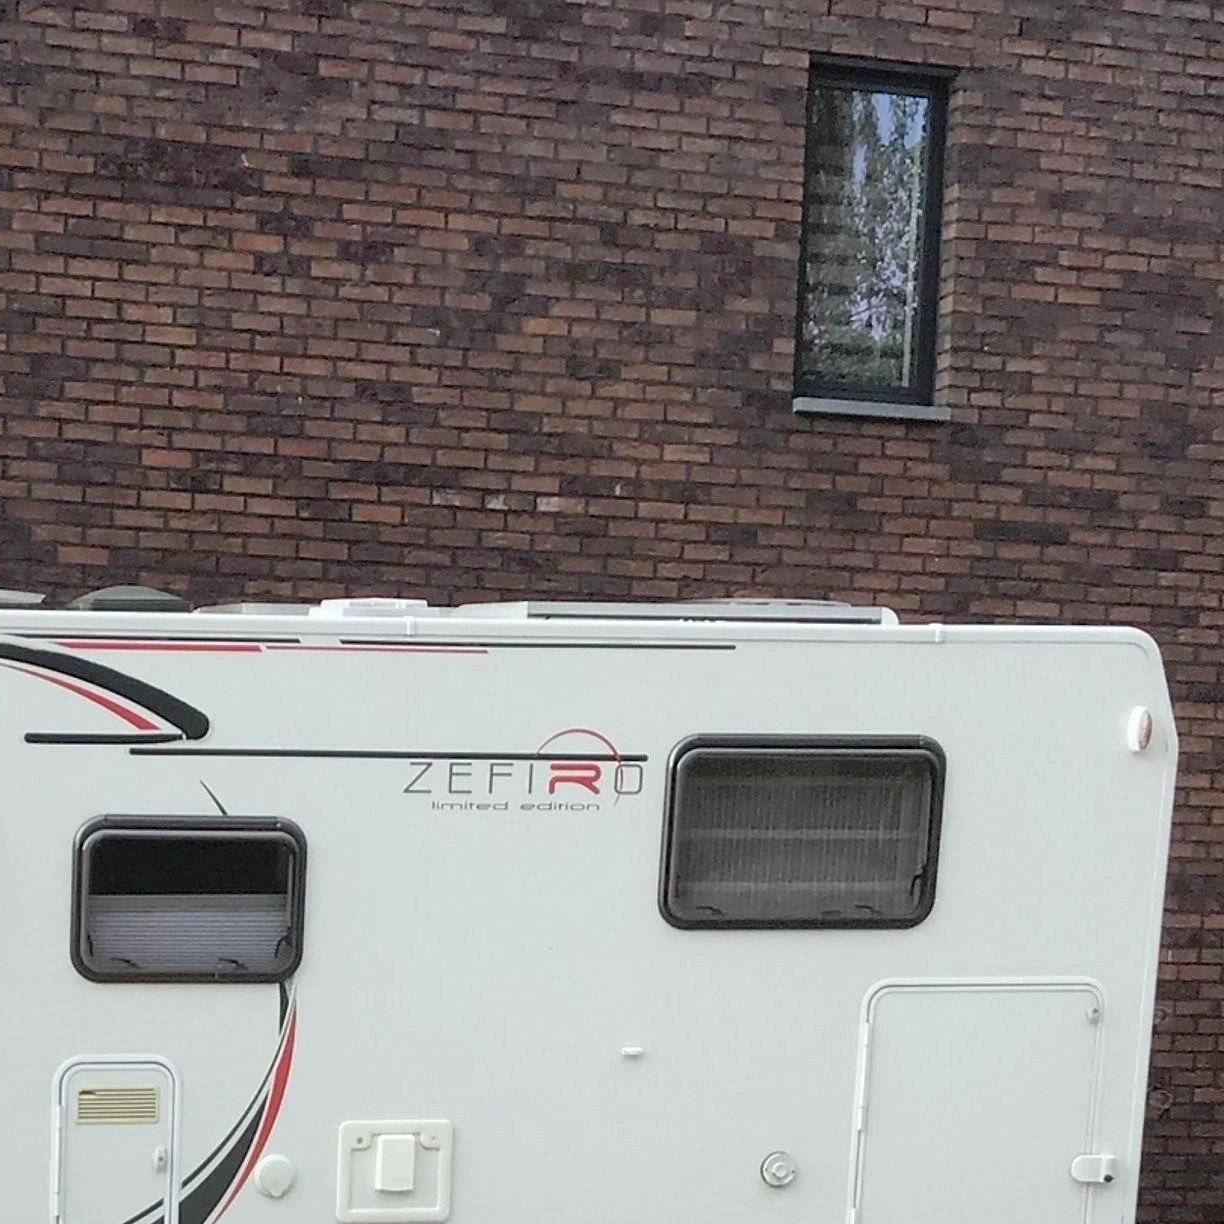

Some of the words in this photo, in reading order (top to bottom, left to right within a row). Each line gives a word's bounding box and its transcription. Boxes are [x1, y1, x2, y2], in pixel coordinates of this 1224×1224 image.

[403, 762, 644, 795] ZEFIRO
[431, 801, 509, 811] limited
[520, 801, 600, 811] edition
